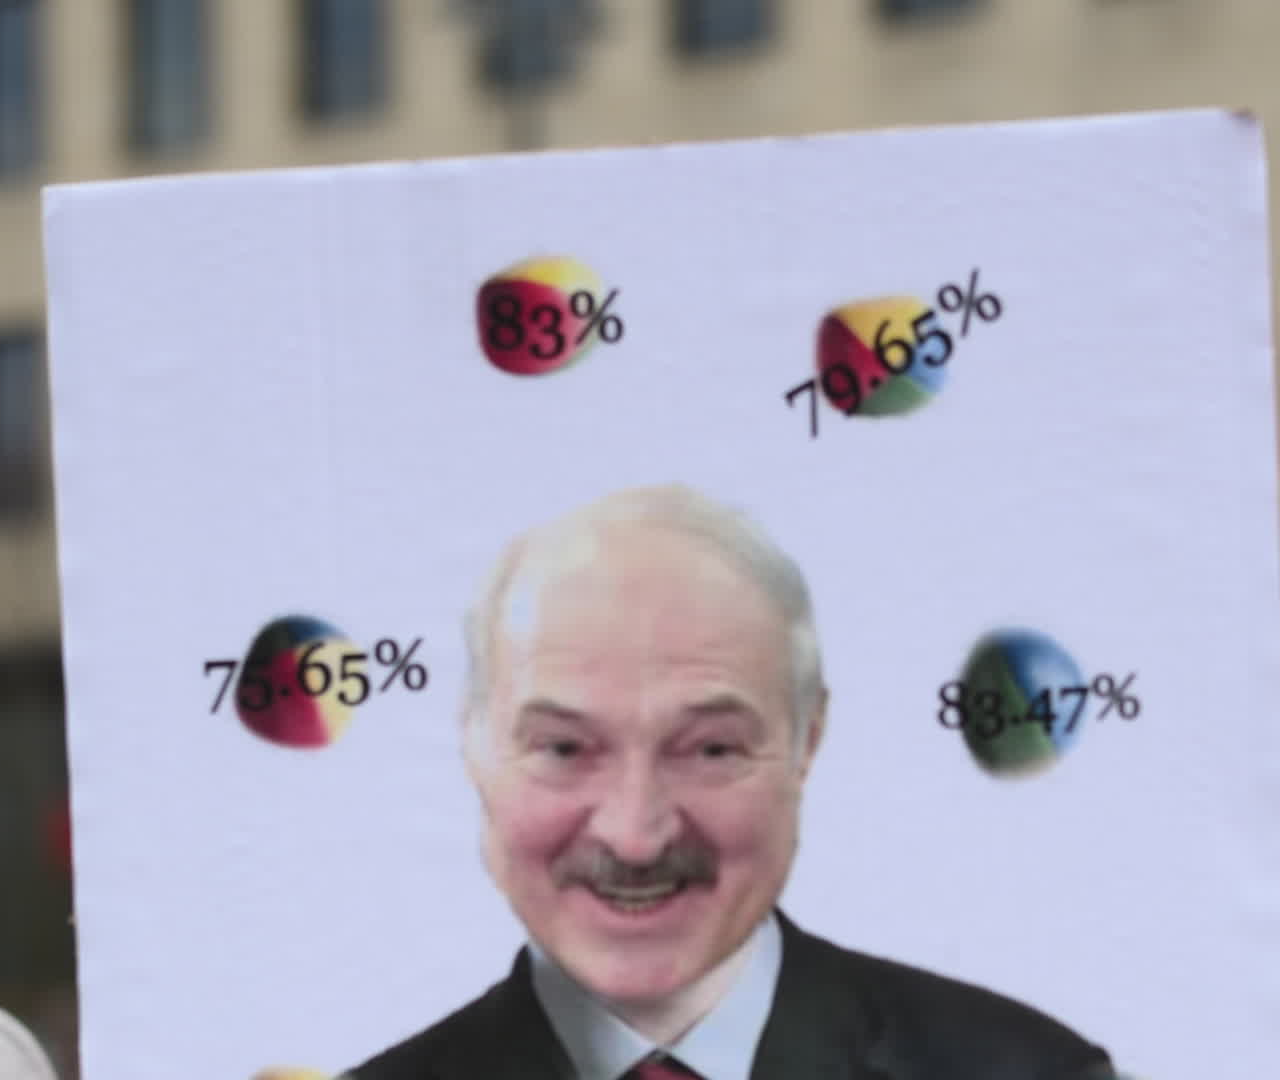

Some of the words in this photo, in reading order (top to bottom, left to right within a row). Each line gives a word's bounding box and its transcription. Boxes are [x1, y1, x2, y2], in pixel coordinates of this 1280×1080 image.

[488, 288, 624, 360] 83%
[784, 267, 1003, 438] 79.65%
[204, 638, 428, 714] 75.65%
[936, 672, 1141, 739] 83.47%
